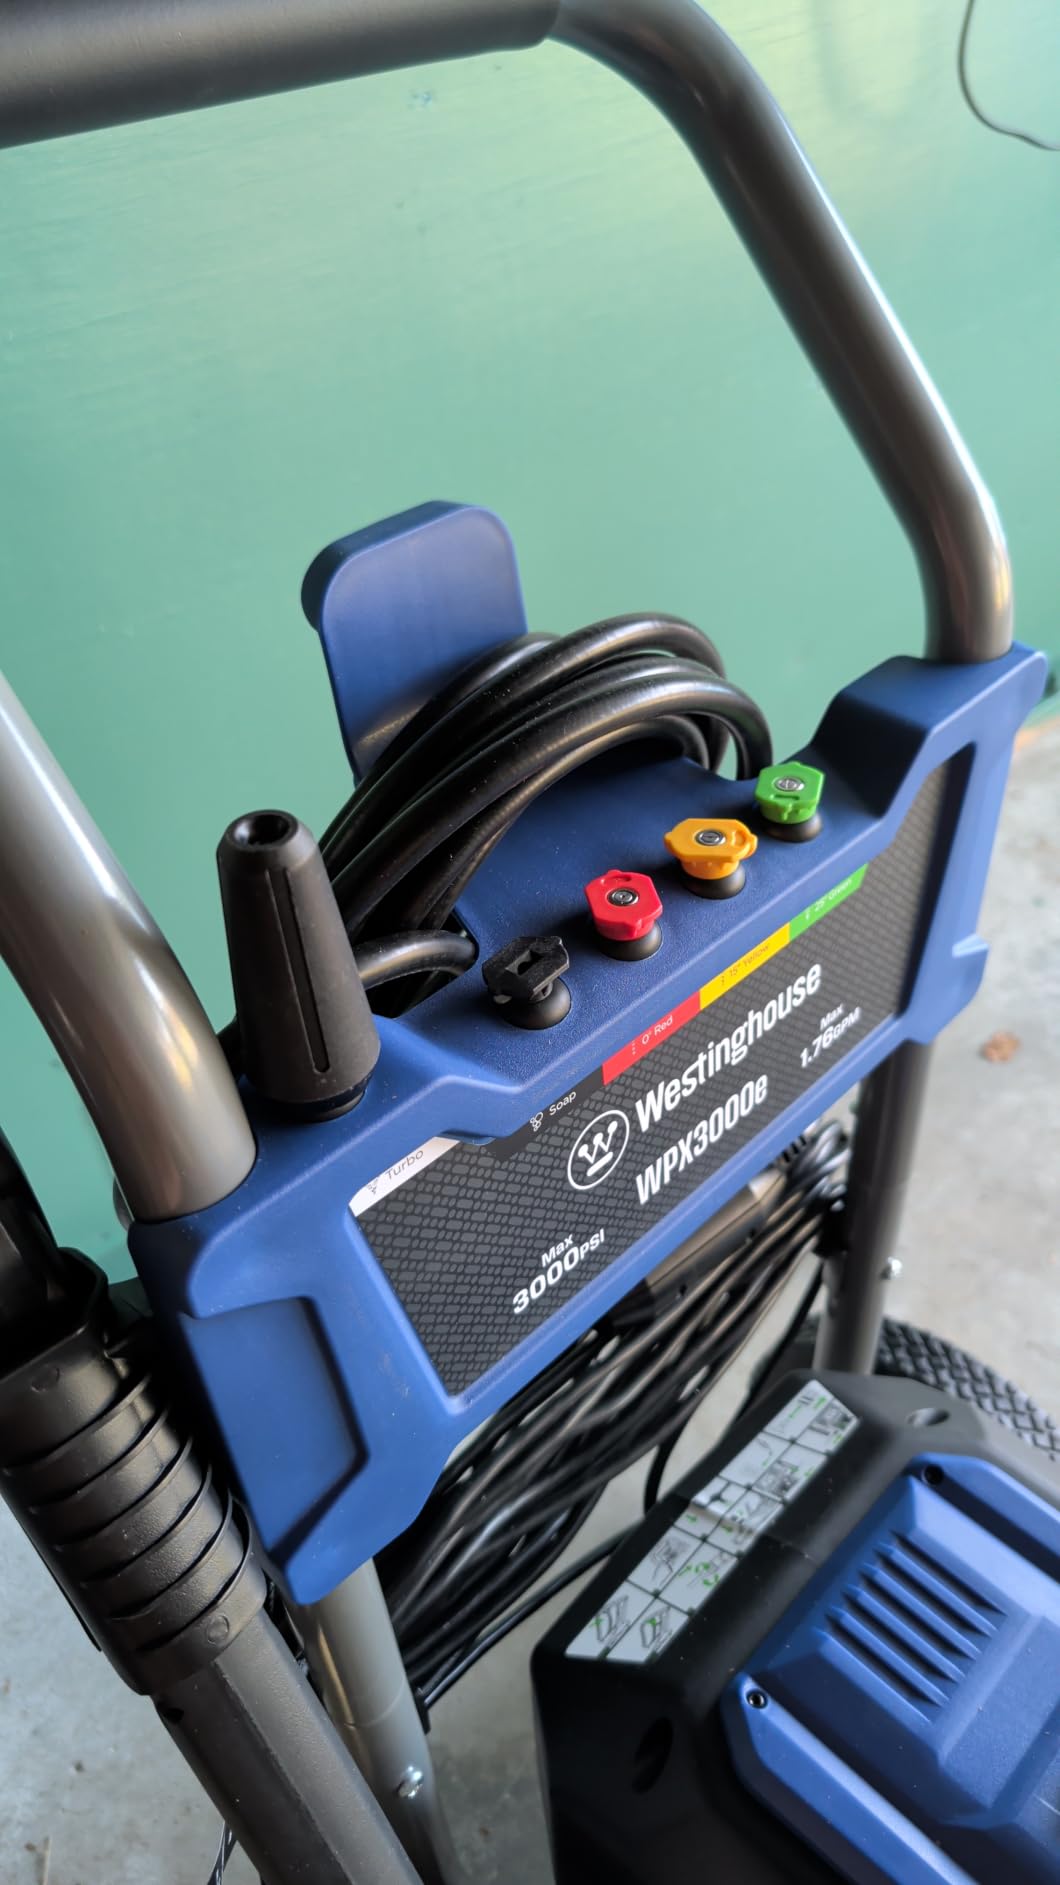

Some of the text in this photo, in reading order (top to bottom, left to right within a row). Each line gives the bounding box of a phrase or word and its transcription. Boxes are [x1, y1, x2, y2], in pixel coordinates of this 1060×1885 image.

[653, 1015, 674, 1035] Red
[820, 1003, 844, 1030] Max
[635, 963, 822, 1134] Westinghouse
[800, 1007, 861, 1068] 1.76GPM
[549, 1091, 577, 1116] Soap
[635, 1074, 768, 1205] WPX3000e
[384, 1149, 425, 1181] Turbo
[541, 1233, 574, 1267] Max
[512, 1228, 605, 1315] 3000PSI
